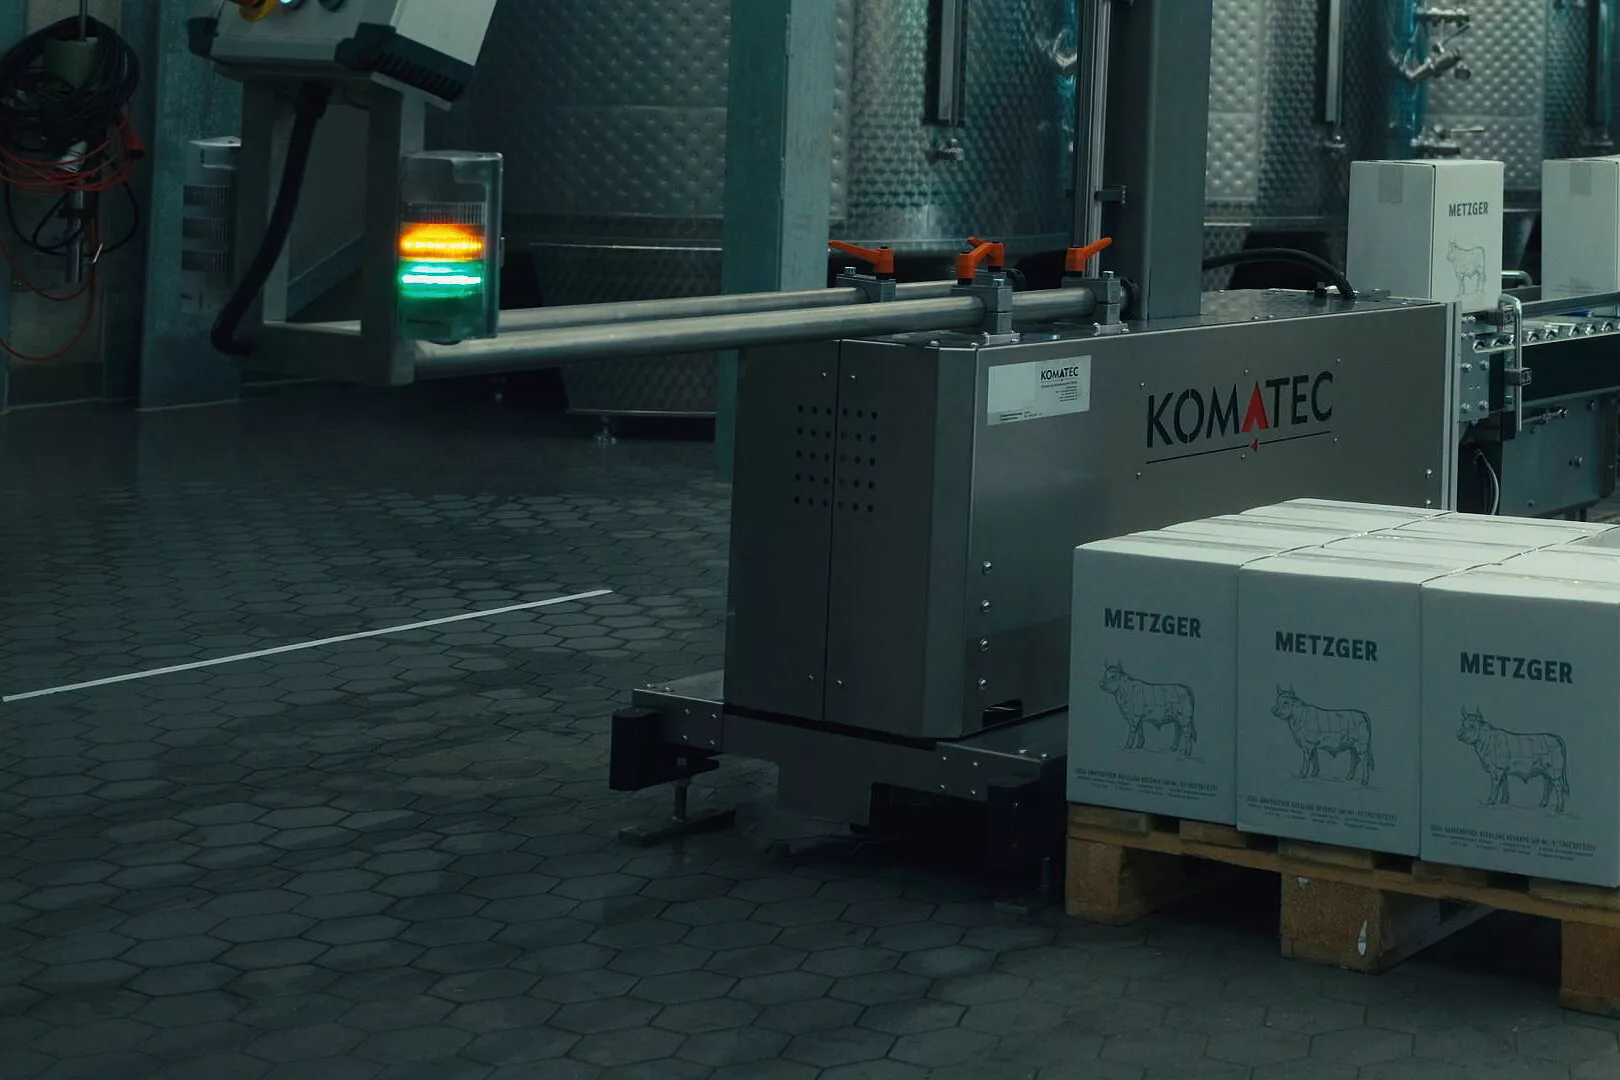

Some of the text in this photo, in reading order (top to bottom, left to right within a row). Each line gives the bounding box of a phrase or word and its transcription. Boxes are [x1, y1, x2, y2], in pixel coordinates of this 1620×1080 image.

[1448, 201, 1489, 217] METZGER
[1041, 366, 1080, 381] KOMATEC
[1146, 371, 1334, 449] KOMATEC
[1104, 607, 1201, 638] METZGER
[1275, 630, 1379, 662] METZGER
[1460, 651, 1573, 684] METZGER
